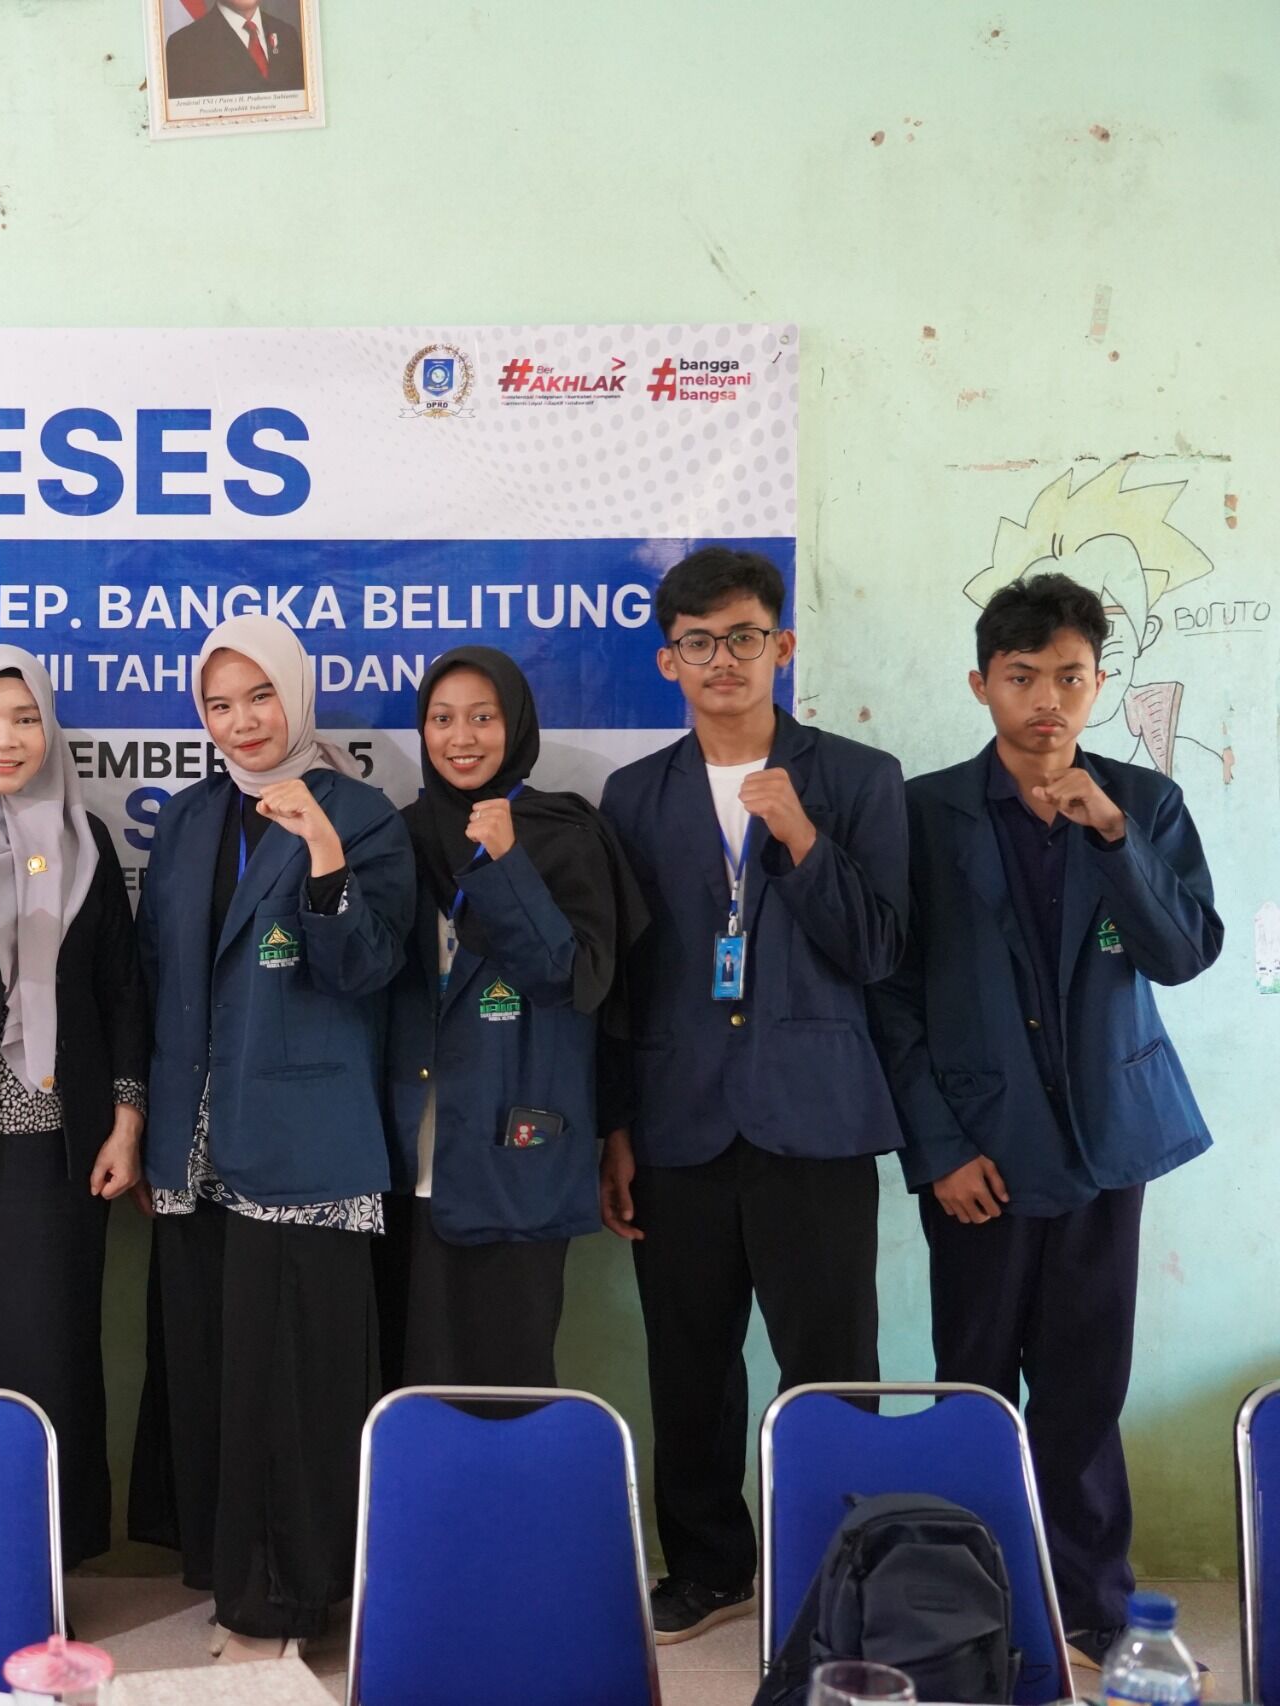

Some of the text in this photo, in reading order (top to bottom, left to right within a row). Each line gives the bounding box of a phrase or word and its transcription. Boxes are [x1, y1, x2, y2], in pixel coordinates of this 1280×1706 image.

[536, 365, 555, 375] Ber
[679, 358, 740, 373] bangga
[679, 372, 752, 388] melayani
[679, 388, 737, 403] bangsa
[99, 584, 346, 629] BANGKA
[363, 583, 652, 629] BELITUNG
[36, 654, 73, 692] II
[88, 654, 201, 692] TAH
